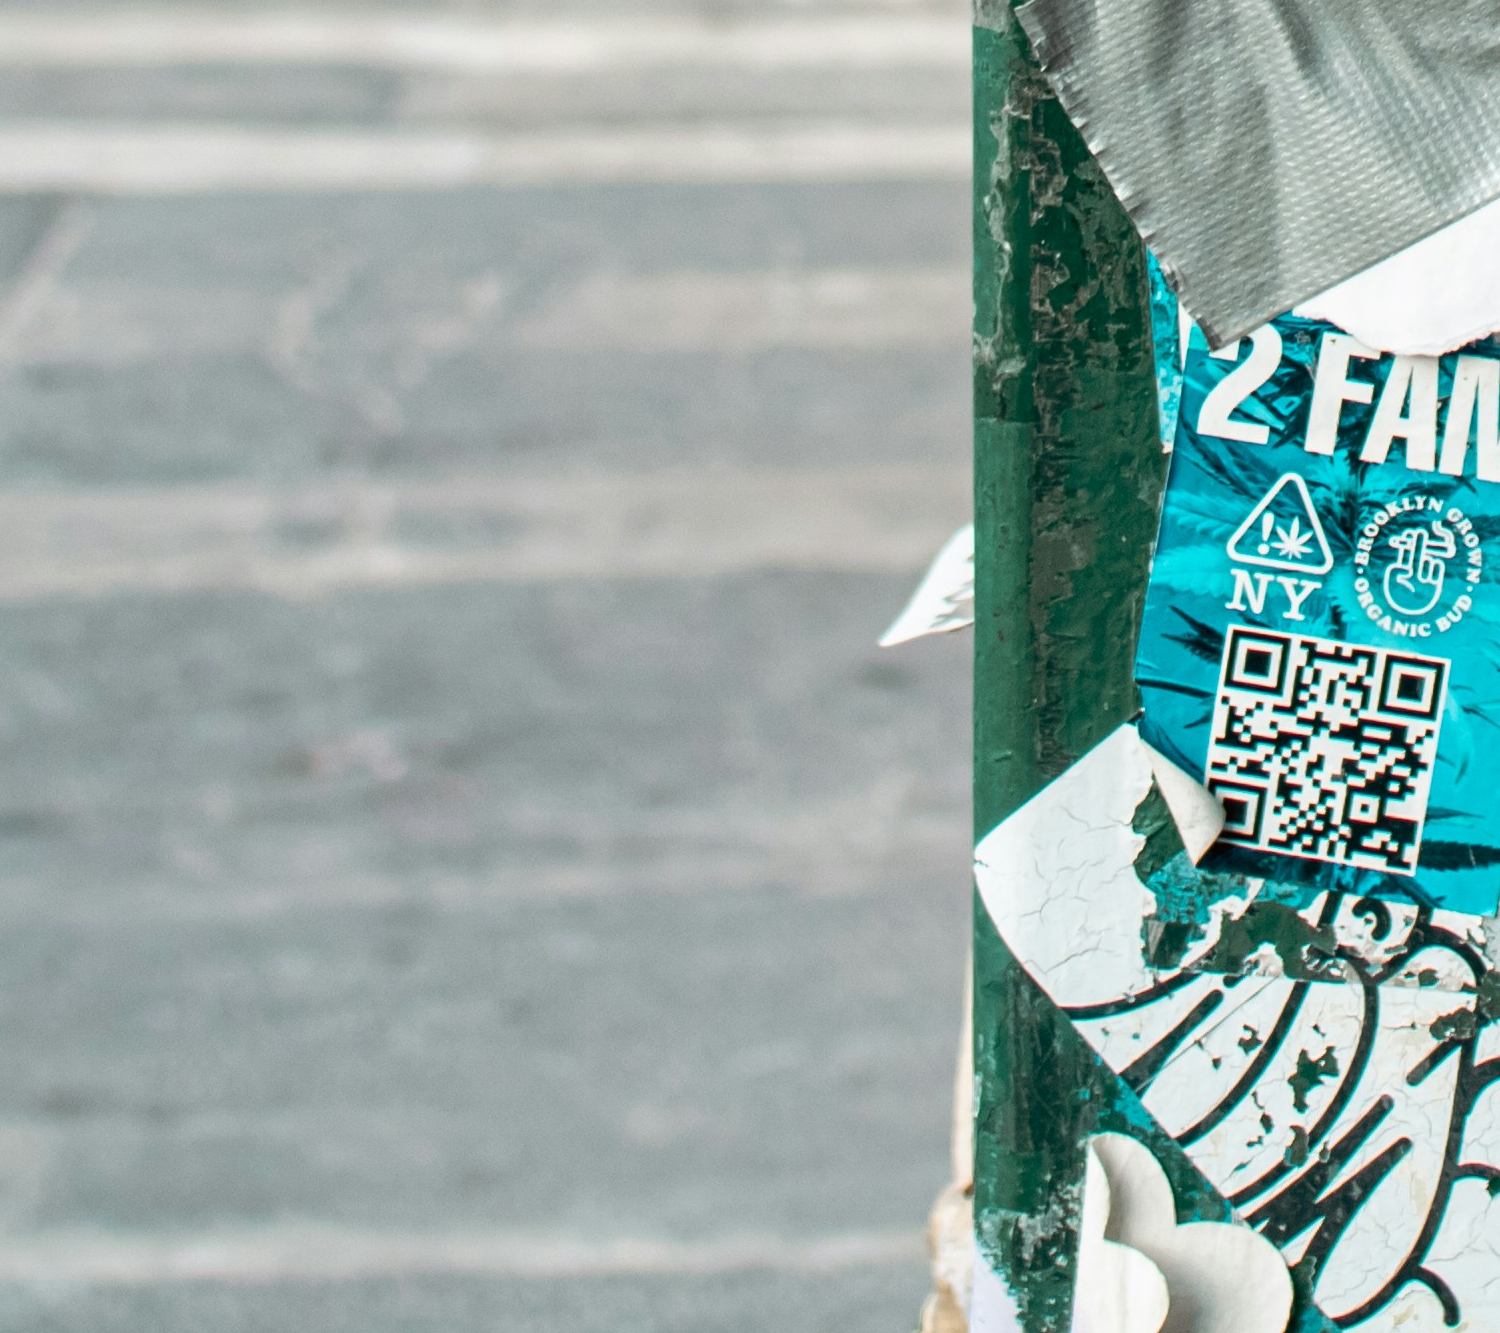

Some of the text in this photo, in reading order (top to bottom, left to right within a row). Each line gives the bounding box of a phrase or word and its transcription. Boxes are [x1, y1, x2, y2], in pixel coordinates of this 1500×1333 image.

[1354, 495, 1482, 584] BROOKLYN GROWN
[1225, 569, 1322, 620] NY
[1354, 577, 1473, 638] ORGANIC BUD
